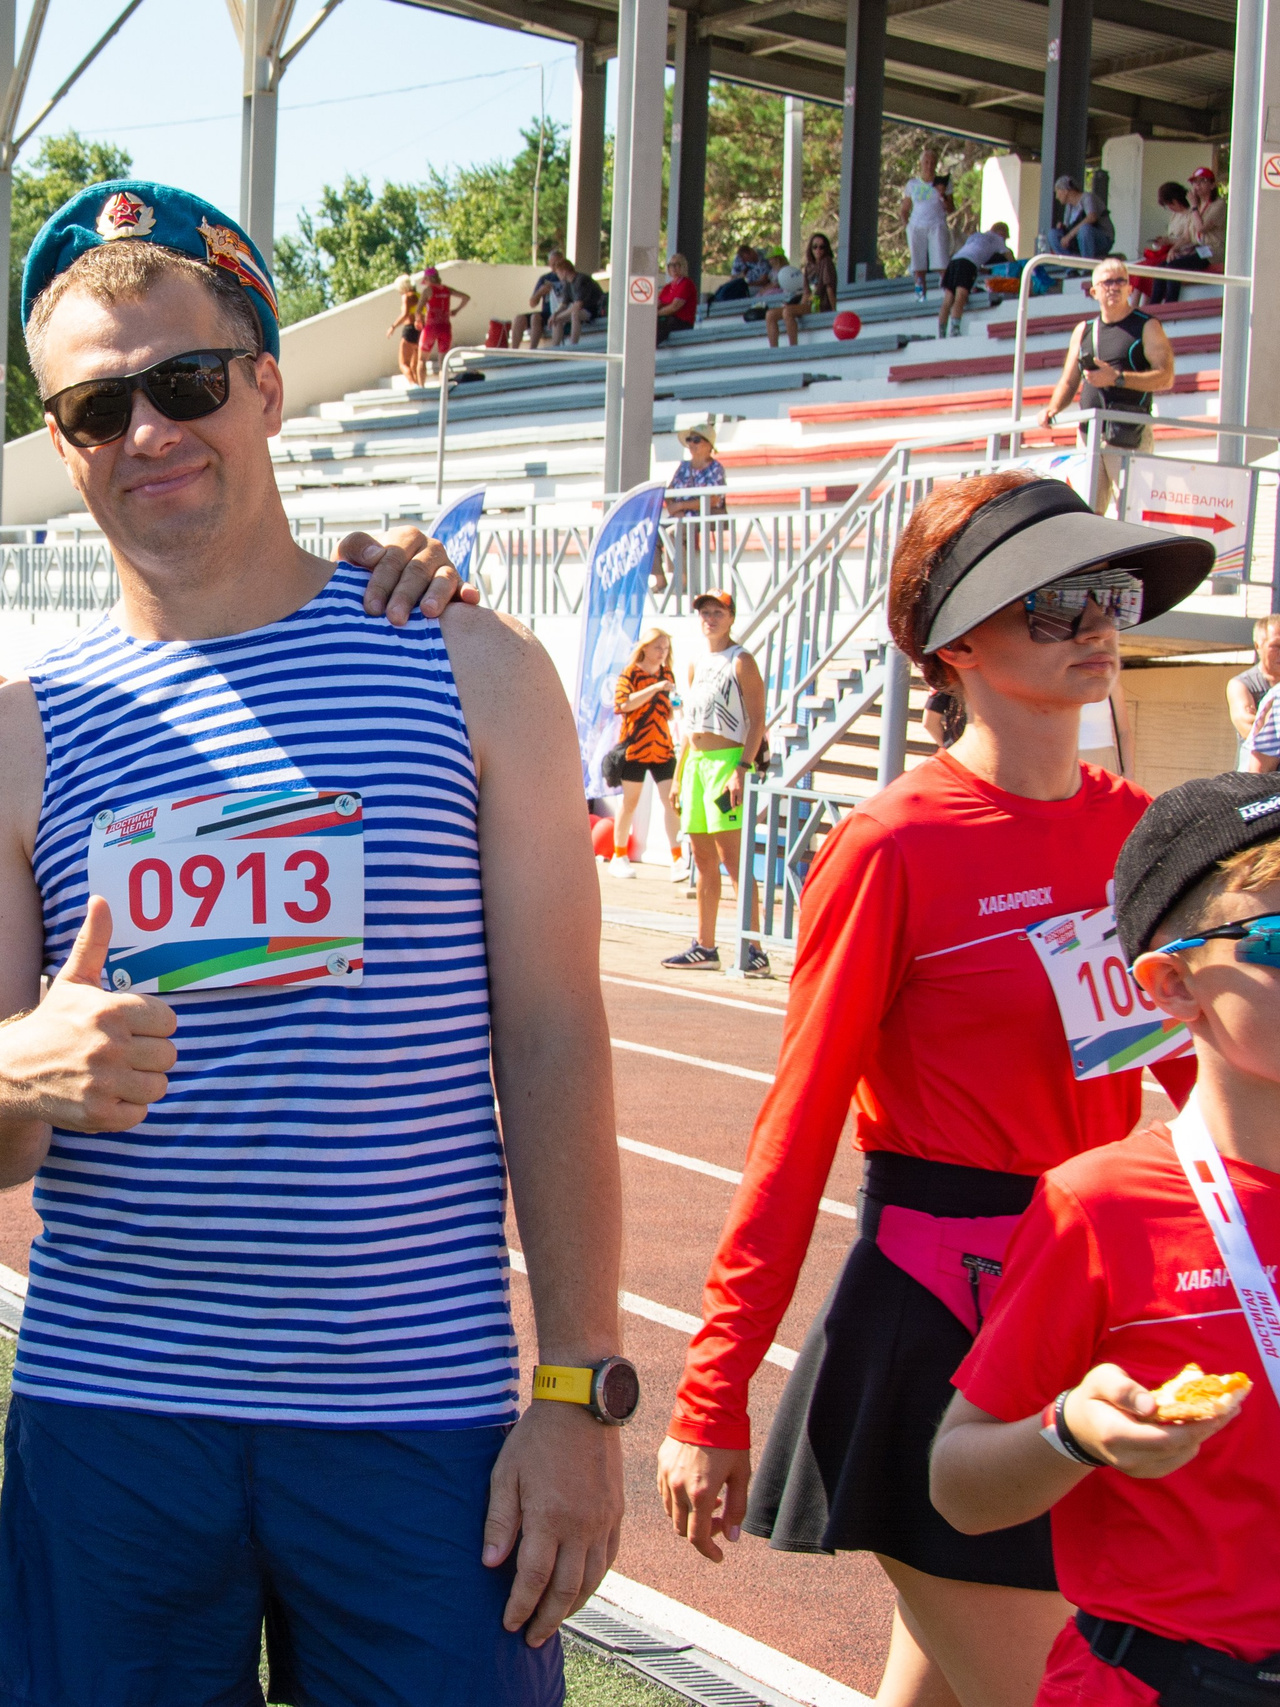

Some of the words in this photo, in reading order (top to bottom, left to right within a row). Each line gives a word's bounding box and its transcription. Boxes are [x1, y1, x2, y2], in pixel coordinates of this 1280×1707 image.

[1150, 489, 1234, 509] РАЗДЕВАЛКИ
[108, 809, 154, 834] ДОСТИГАЯ
[122, 818, 153, 836] ЦЕЛИ!
[128, 850, 332, 932] 0913
[978, 886, 1053, 917] ХАБАРОВСК
[1241, 1288, 1280, 1359] ДОСТИГАЯ
